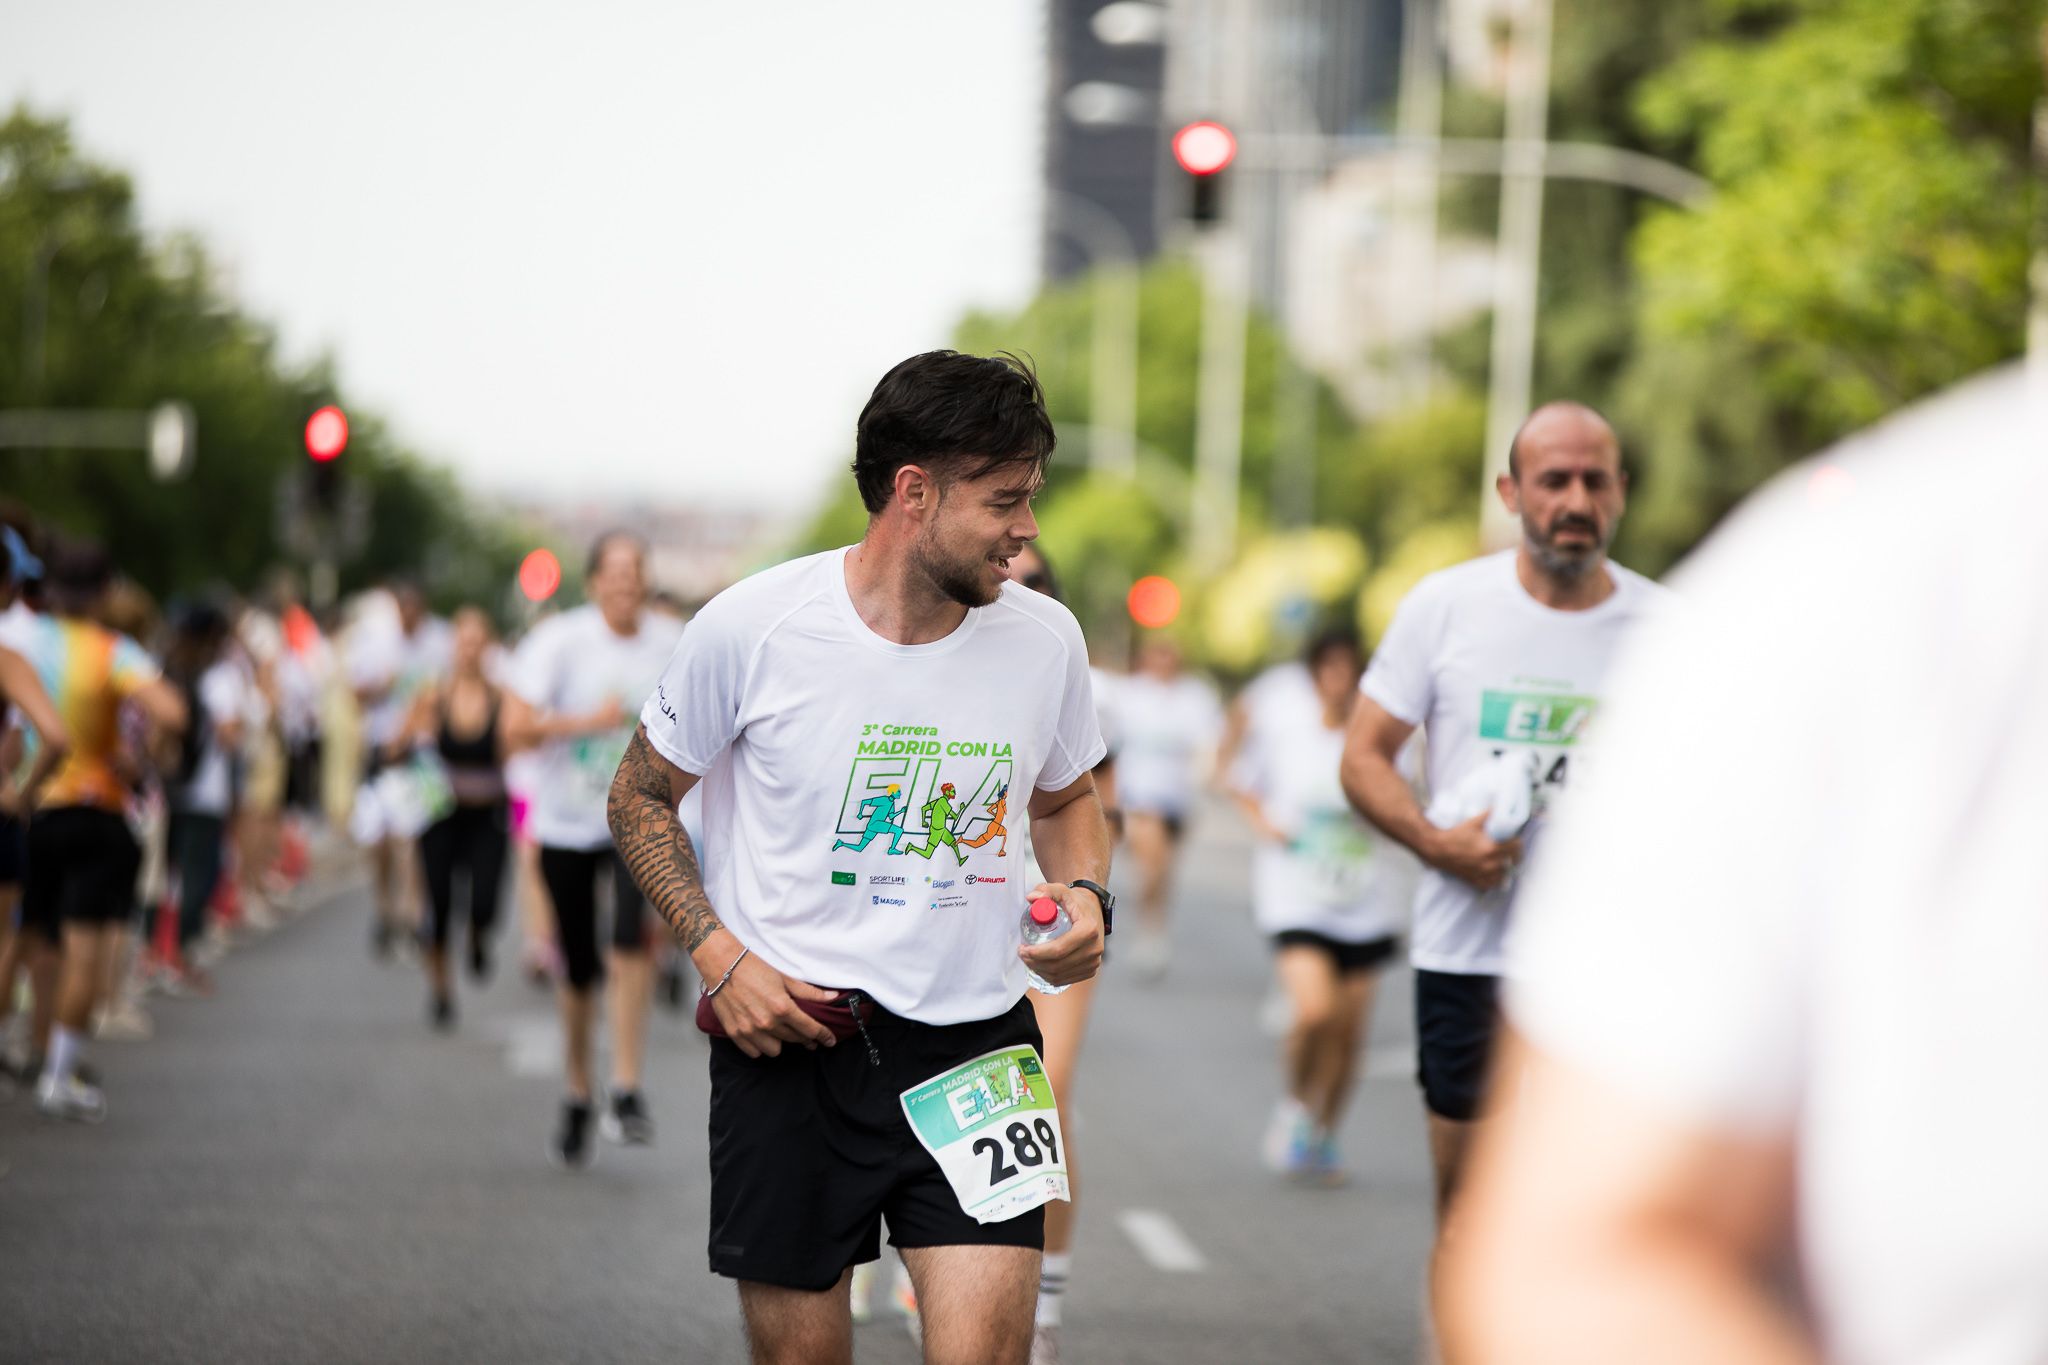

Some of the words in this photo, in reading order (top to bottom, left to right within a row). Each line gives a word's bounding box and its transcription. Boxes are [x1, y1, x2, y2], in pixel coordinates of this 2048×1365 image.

[882, 724, 938, 736] Carrera
[857, 740, 941, 755] MADRID
[945, 741, 987, 757] CON
[991, 743, 1012, 757] LA
[835, 757, 1013, 835] ELA
[932, 880, 955, 889] Biogen
[880, 898, 905, 906] MADRID
[942, 1067, 981, 1092] MADRID
[983, 1060, 1002, 1073] CON
[1002, 1056, 1014, 1066] LA
[946, 1065, 1036, 1131] ELA
[972, 1117, 1059, 1187] 289
